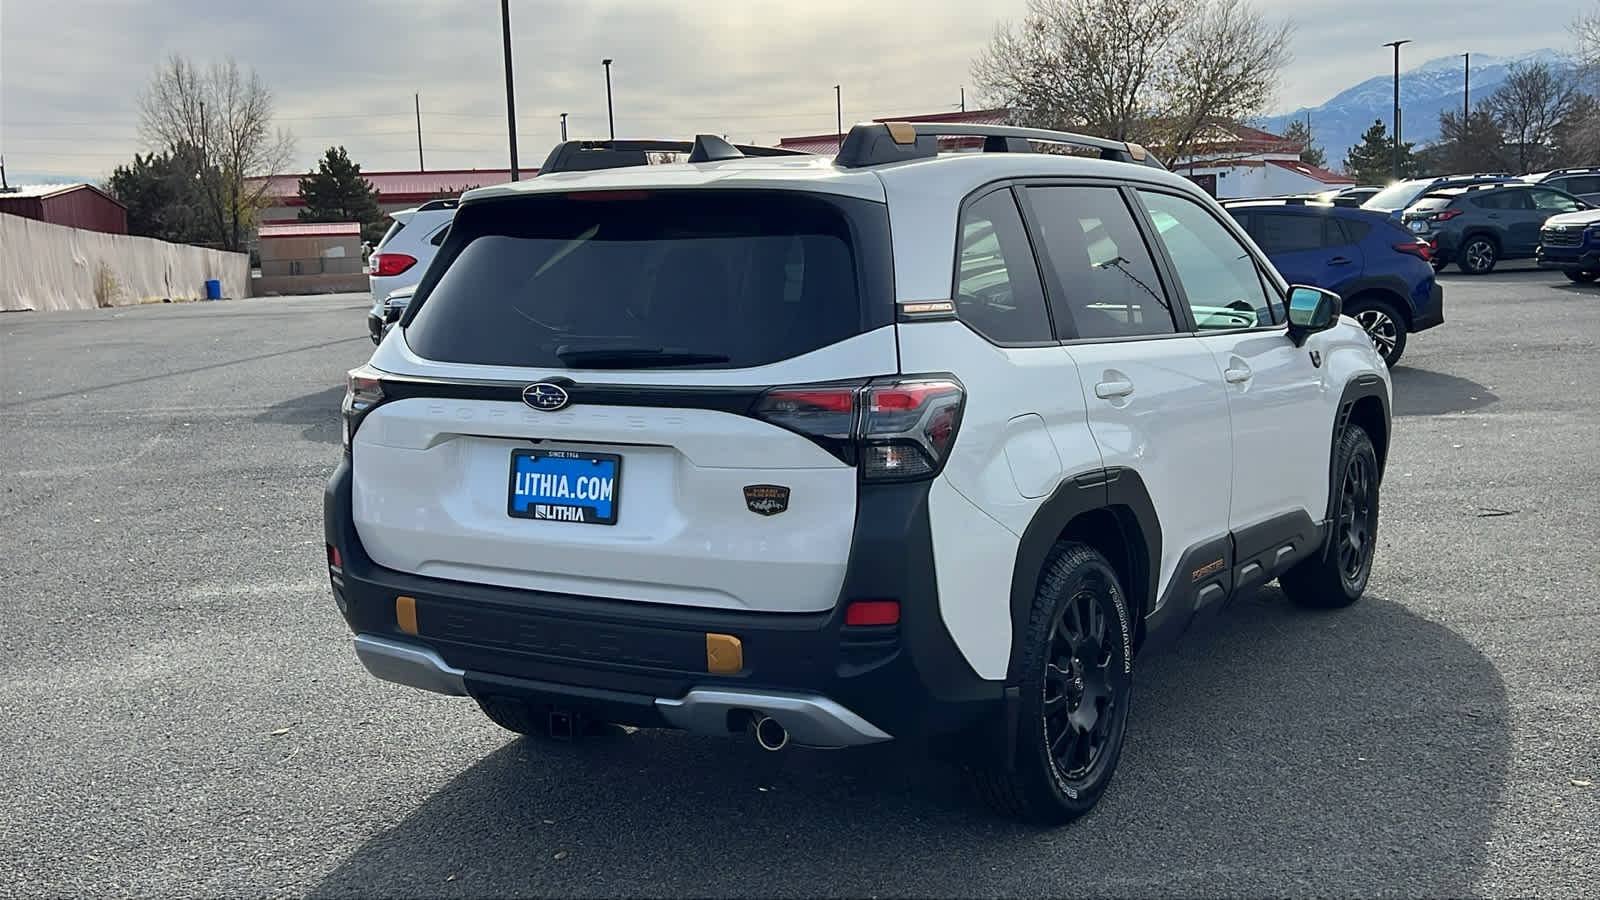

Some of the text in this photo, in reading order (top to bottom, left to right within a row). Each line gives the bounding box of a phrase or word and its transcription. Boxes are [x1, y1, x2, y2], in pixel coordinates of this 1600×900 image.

[548, 451, 565, 459] SINCE
[515, 472, 614, 502] LITHIA.COM
[546, 504, 584, 522] LITHIA
